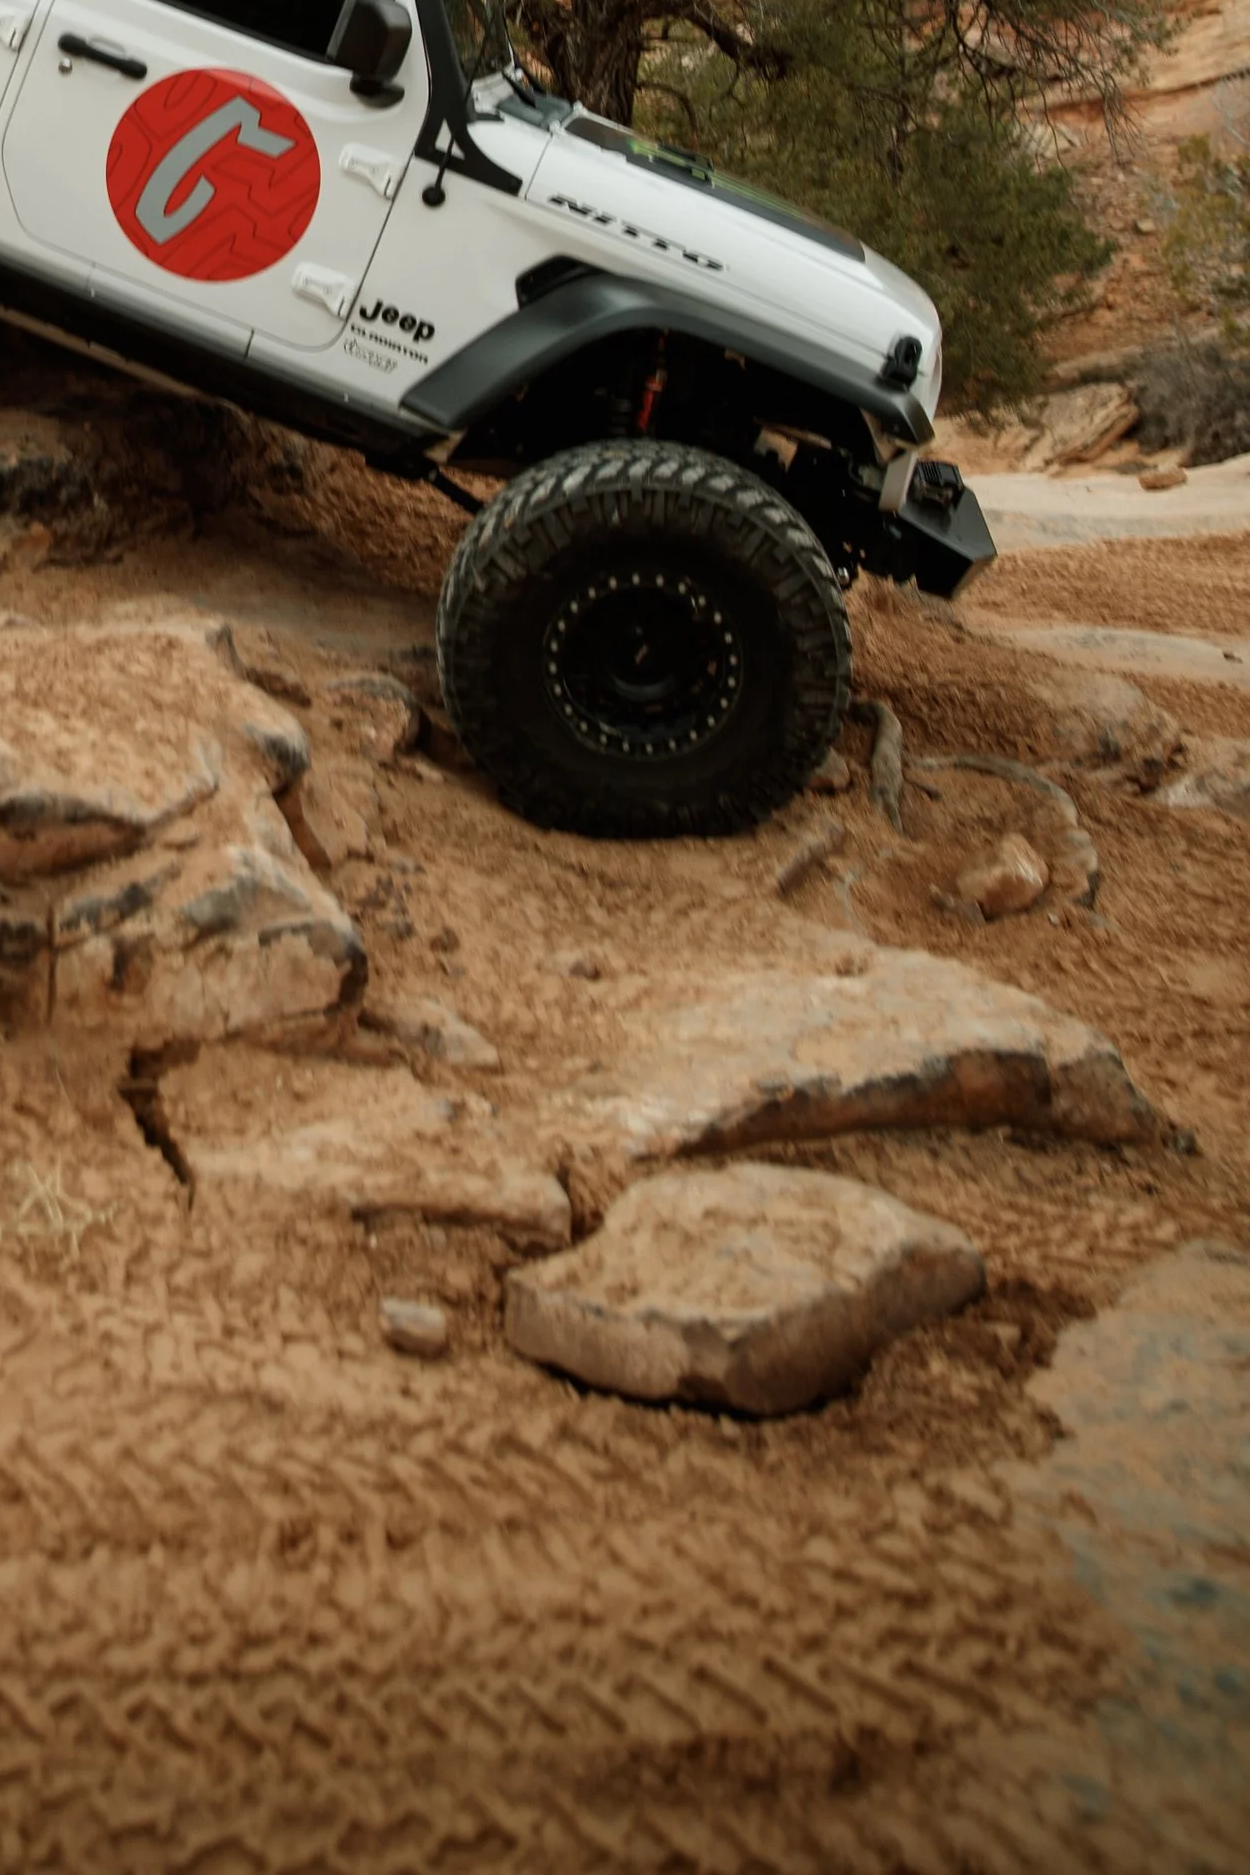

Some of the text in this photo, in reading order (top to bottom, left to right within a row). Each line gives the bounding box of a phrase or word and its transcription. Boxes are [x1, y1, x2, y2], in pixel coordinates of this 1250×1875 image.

[549, 194, 726, 272] NITTO
[359, 298, 436, 343] Jeep
[351, 323, 429, 365] GLADIATOR
